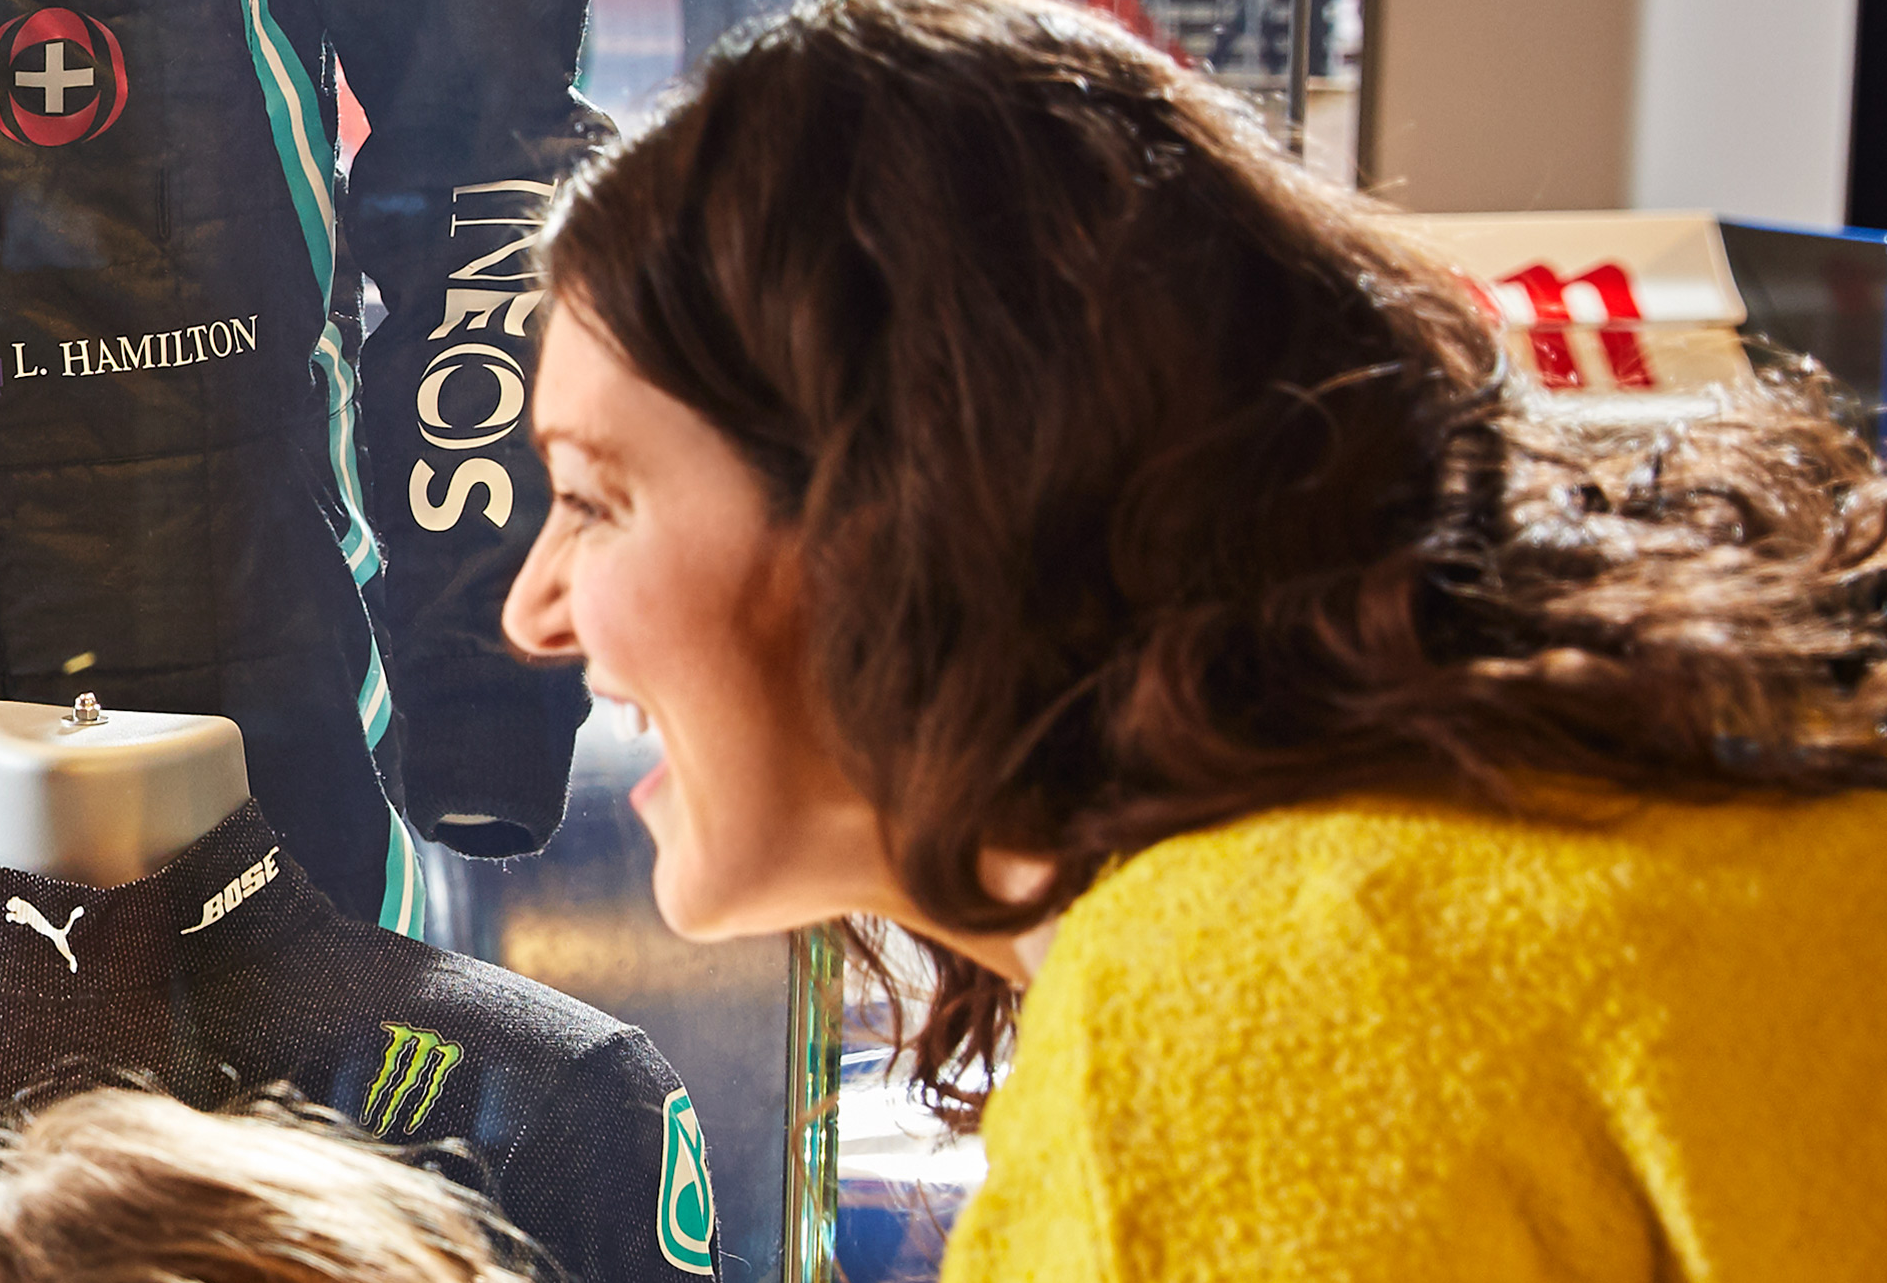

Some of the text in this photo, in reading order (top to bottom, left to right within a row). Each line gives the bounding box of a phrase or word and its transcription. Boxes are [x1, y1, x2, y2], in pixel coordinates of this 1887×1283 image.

[11, 342, 49, 378] L.
[59, 315, 259, 377] HAMILTON
[408, 178, 560, 533] INEOS
[181, 846, 280, 935] BOSE
